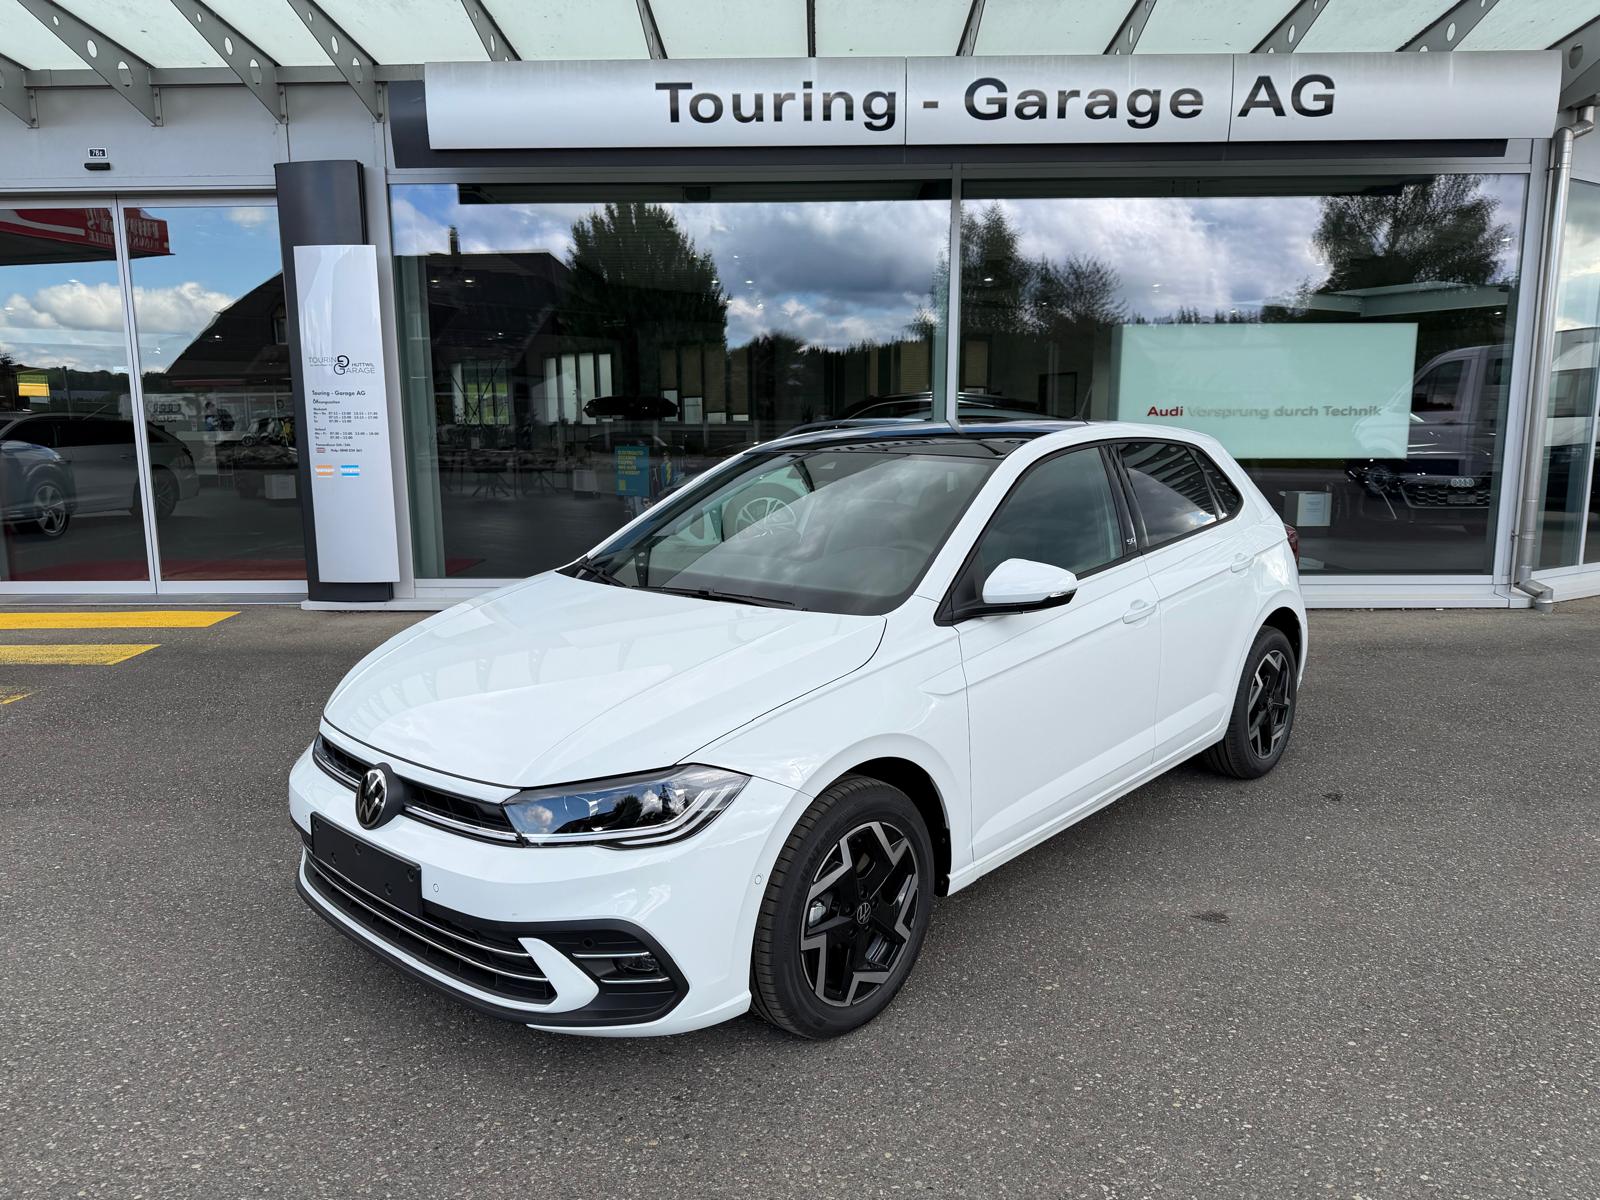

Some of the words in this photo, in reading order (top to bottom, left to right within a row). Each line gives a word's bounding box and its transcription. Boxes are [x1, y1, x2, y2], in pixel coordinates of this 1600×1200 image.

[655, 80, 897, 132] Touring
[964, 76, 1204, 130] Garage
[1237, 73, 1336, 118] AG
[1147, 406, 1184, 417] Audi
[1187, 405, 1269, 420] Vorsprung
[1273, 405, 1319, 417] durch
[1322, 405, 1382, 417] Technik
